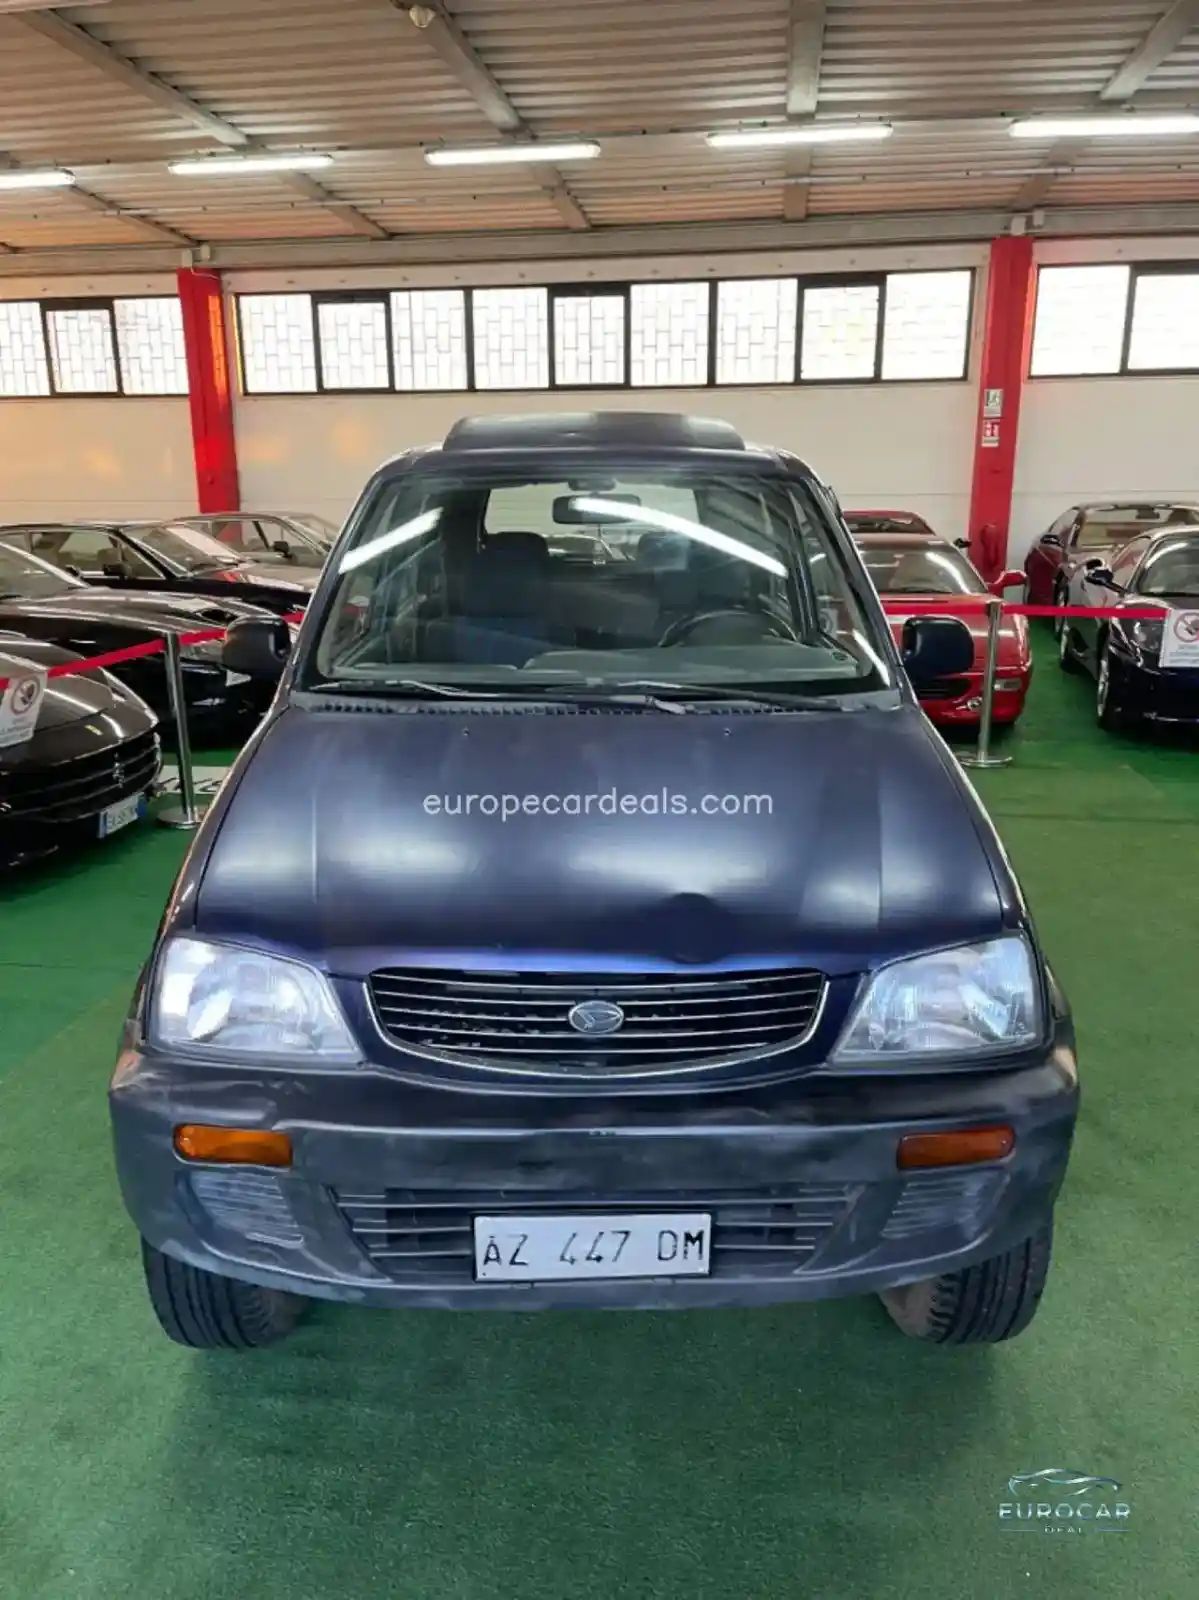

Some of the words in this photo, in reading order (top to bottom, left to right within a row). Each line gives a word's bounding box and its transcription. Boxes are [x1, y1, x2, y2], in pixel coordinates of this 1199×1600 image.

[483, 1233, 529, 1266] AZ
[559, 1230, 632, 1265] 447
[656, 1229, 705, 1262] DM
